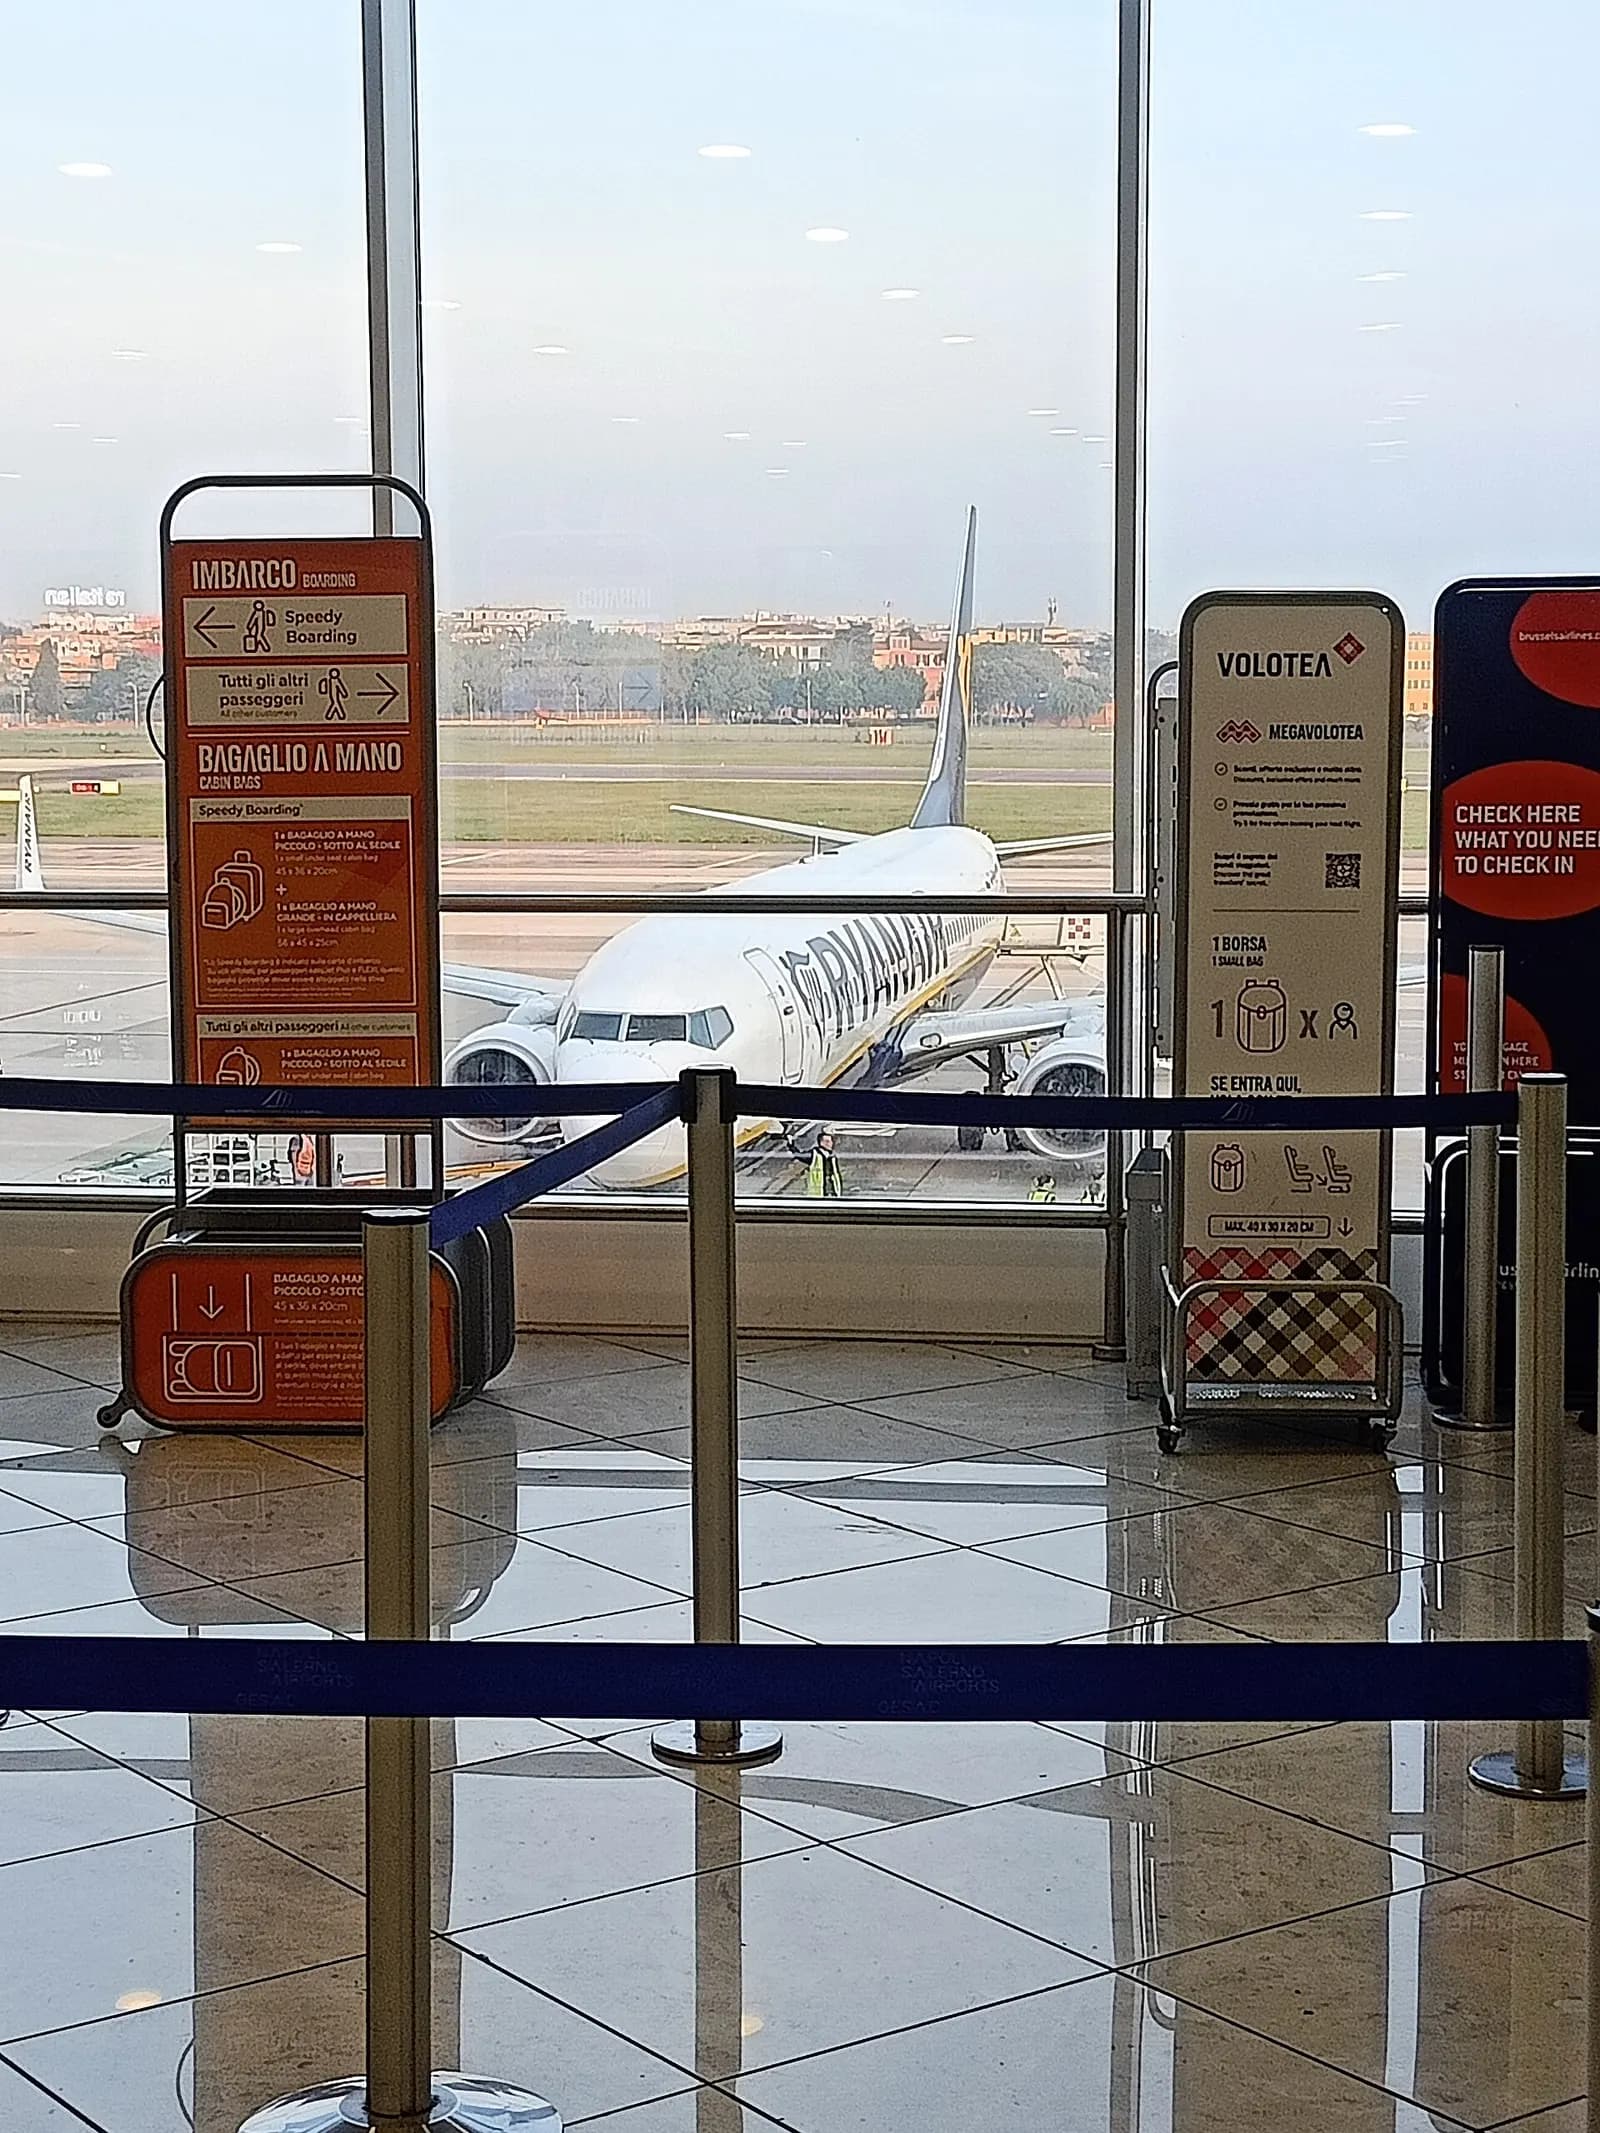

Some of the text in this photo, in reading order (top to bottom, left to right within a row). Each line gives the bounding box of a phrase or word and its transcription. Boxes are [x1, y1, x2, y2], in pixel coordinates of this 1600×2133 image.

[192, 560, 356, 589] IMBARCO BOARDING
[284, 609, 343, 627] Speedy
[286, 630, 357, 645] Boarding
[1217, 652, 1333, 677] VOLOTEA
[218, 673, 309, 689] Tutti gli altri
[219, 692, 304, 708] passeggeri
[1269, 724, 1364, 740] MEGAVOLOTEA
[198, 743, 401, 773] BAGAGLIO A MANO
[199, 776, 262, 790] CABIN BAGS
[199, 804, 243, 817] Speedy
[1456, 805, 1581, 823] CHECK HERE
[287, 831, 335, 839] BAGAGLIO
[337, 831, 344, 839] A
[345, 831, 375, 839] MANO
[1455, 830, 1600, 849] WHAT YOU NEE
[275, 841, 316, 850] PICCOLO
[323, 841, 354, 850] SOTTO
[355, 841, 368, 850] AL
[369, 841, 401, 850] SEDILE
[1455, 855, 1574, 874] TO CHECK IN
[289, 903, 337, 911] BAGAGLIO
[338, 903, 346, 911] A
[347, 903, 376, 911] MANO
[276, 912, 316, 922] GRANDE
[323, 912, 334, 922] IN
[335, 912, 398, 922] CAPPELLIERA
[1212, 936, 1268, 951] 1 BORSA
[1212, 955, 1264, 967] 1 SMALL BAG
[1211, 1000, 1224, 1038] 1
[205, 1021, 231, 1033] Tutti
[233, 1021, 249, 1033] gli
[250, 1021, 273, 1033] altri
[275, 1021, 339, 1033] passeggeri
[293, 1049, 342, 1057] BAGAGLIO
[343, 1049, 350, 1057] A
[351, 1049, 381, 1057] MANO
[1502, 1042, 1528, 1052] GAGE
[281, 1059, 322, 1068] PICCOLO
[329, 1059, 360, 1068] SOTTO
[361, 1059, 374, 1068] AL
[375, 1059, 407, 1068] SEDILE
[1511, 1056, 1539, 1066] HERE
[1210, 1076, 1302, 1093] SE ENTRA QUI,
[273, 1273, 364, 1283] BAGAGLIO A MAN
[273, 1286, 322, 1296] PICCOLO
[273, 1301, 288, 1311] 45
[296, 1301, 310, 1311] 36
[318, 1301, 348, 1311] 20cm
